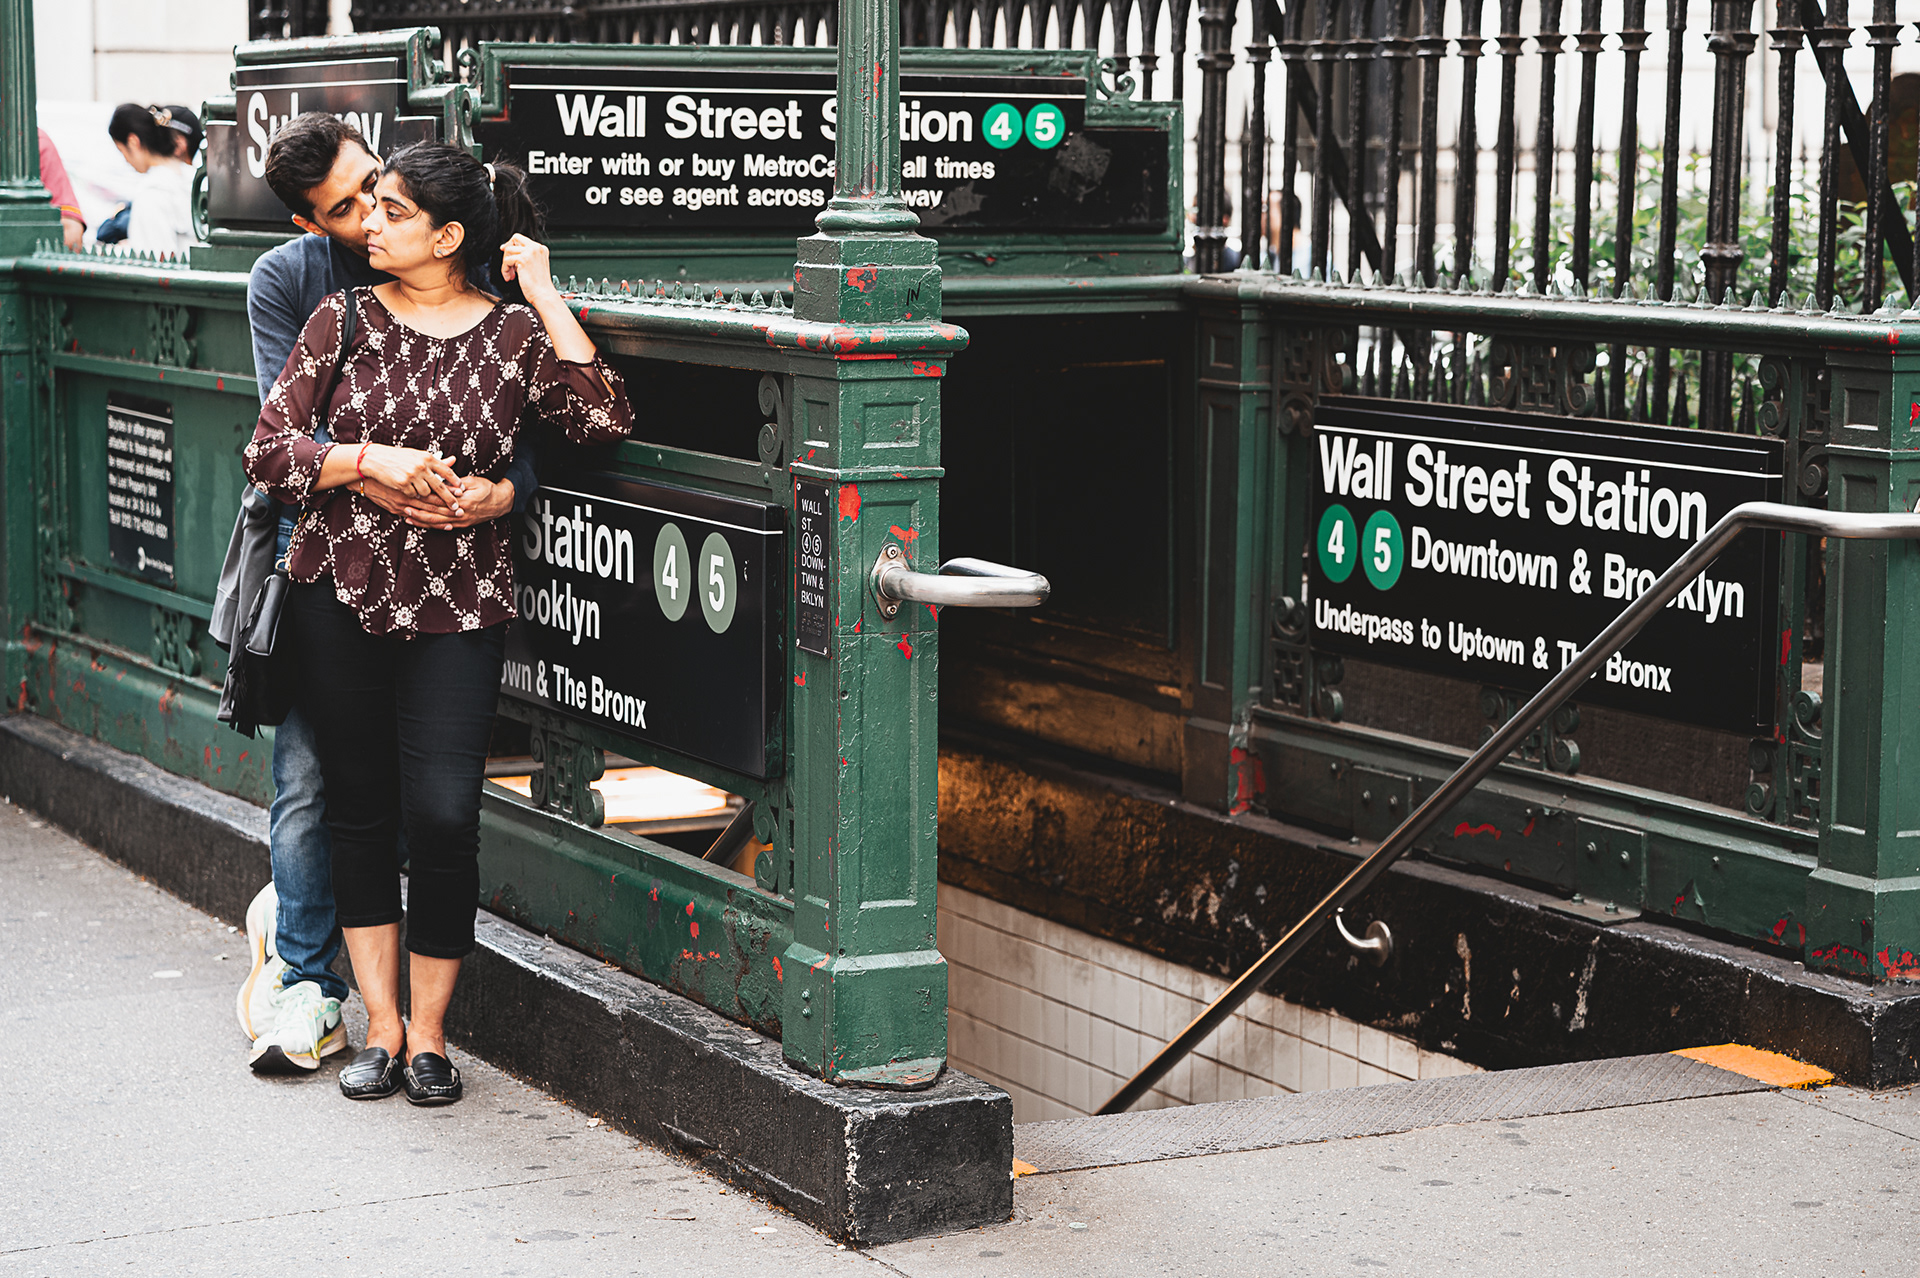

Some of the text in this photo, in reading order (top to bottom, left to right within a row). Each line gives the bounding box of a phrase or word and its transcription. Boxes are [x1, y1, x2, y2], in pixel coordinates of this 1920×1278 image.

[556, 93, 646, 137] Wall
[664, 95, 802, 140] Street
[990, 112, 1012, 141] 4
[1034, 112, 1056, 141] 5
[527, 150, 996, 181] Enter with or buy MetroCa all times
[585, 186, 611, 205] or
[619, 187, 664, 206] see
[672, 184, 739, 211] agent
[746, 188, 825, 207] across
[801, 498, 823, 516] WALL
[1319, 433, 1707, 542] Wall Street Station
[801, 516, 814, 533] ST.
[522, 496, 726, 613] Station 4 5
[1327, 519, 1346, 565] 4
[1373, 527, 1392, 573] 5
[1411, 525, 1558, 590] Downtown
[1568, 548, 1593, 596] &
[801, 571, 825, 591] TWN &
[801, 589, 825, 609] BKLYN
[513, 579, 600, 646] rooklyn
[1315, 598, 1414, 645] Underpass
[1420, 617, 1442, 650] to
[1448, 620, 1525, 665] Uptown
[1532, 636, 1549, 670] &
[1605, 650, 1672, 693] Bronx
[536, 659, 550, 699] &
[552, 663, 587, 710] The
[591, 674, 647, 730] Bronx
